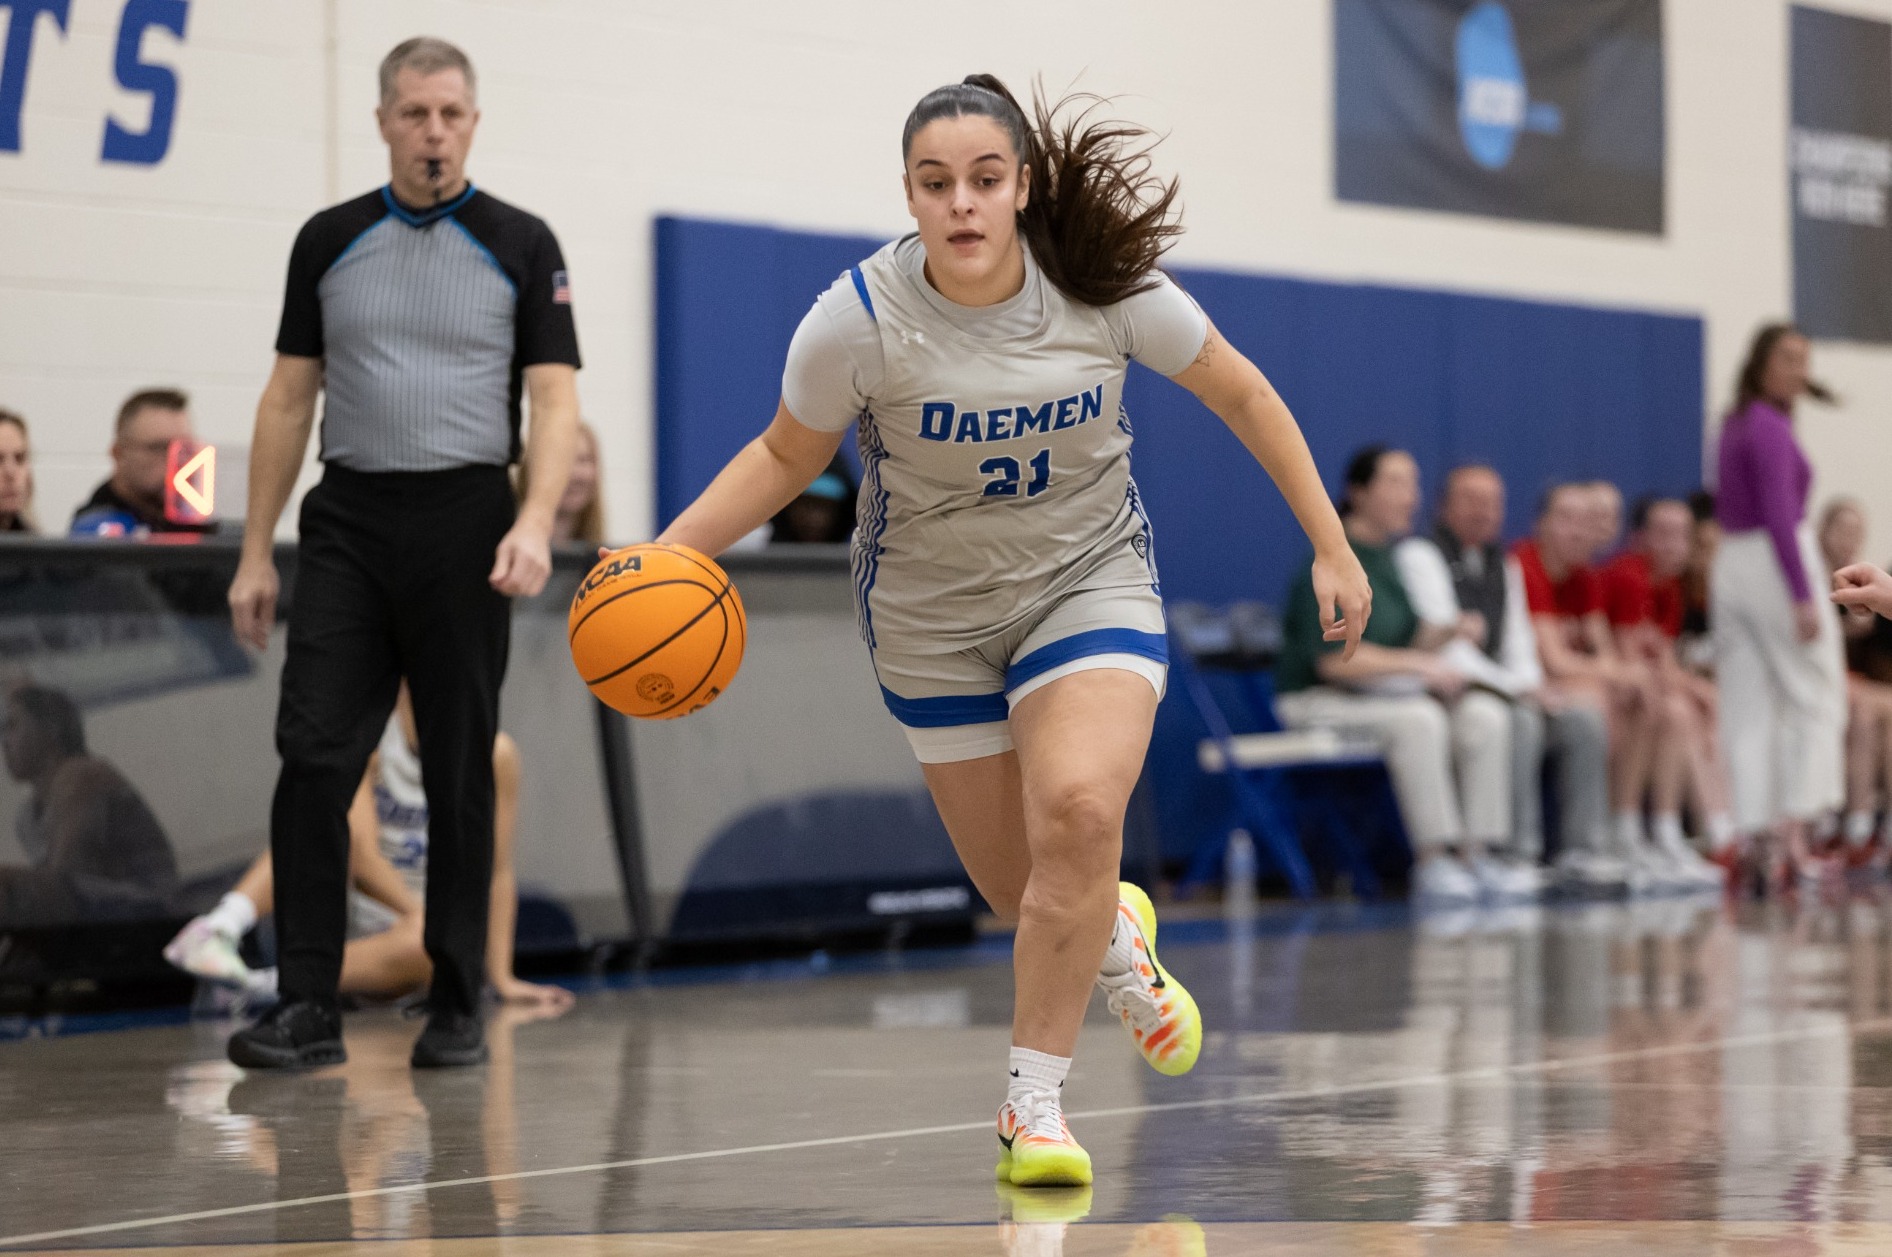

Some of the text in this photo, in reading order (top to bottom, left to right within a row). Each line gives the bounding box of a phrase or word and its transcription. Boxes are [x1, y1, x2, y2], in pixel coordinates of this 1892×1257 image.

[918, 383, 1103, 443] DAEMEN
[978, 449, 1051, 498] 21
[574, 556, 642, 610] NCAA
